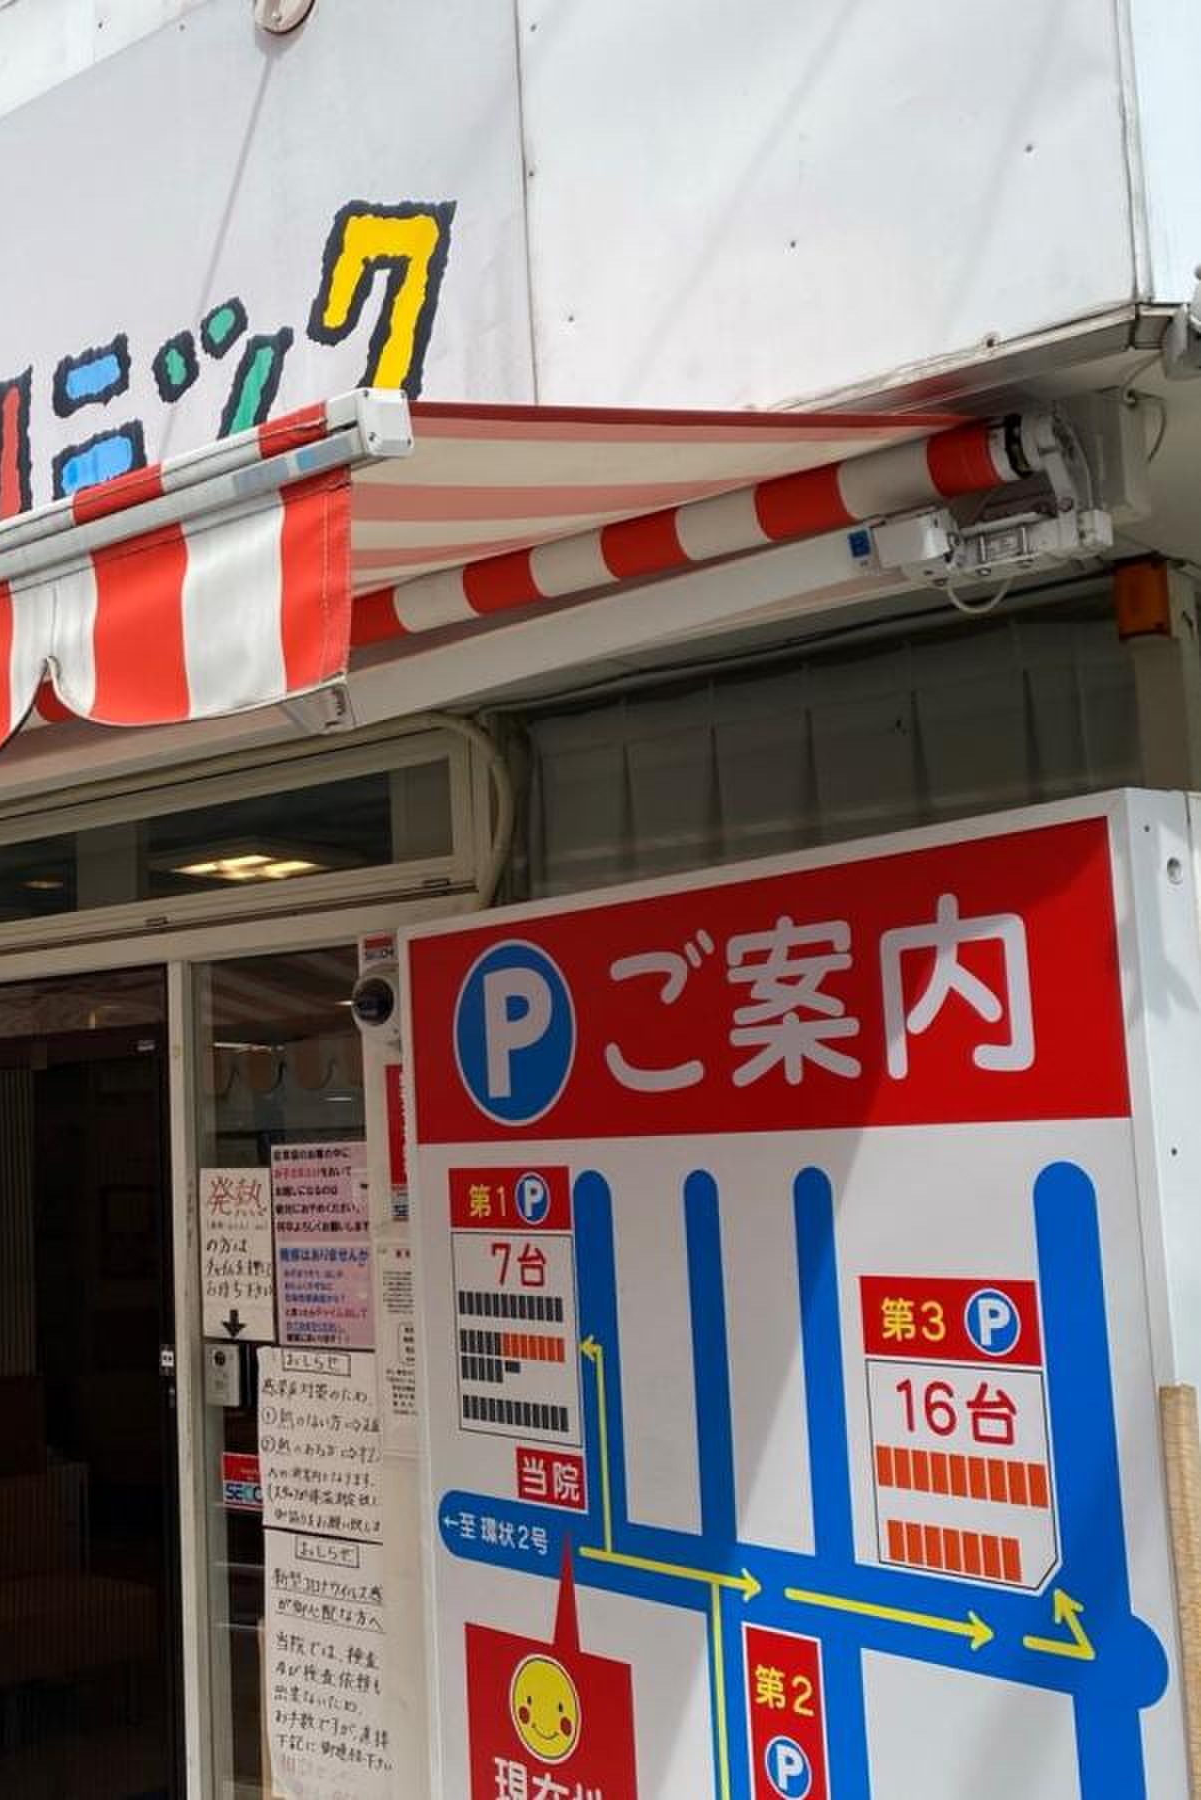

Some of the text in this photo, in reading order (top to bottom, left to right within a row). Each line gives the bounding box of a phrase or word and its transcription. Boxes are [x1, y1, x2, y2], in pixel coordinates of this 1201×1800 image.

[604, 893, 1036, 1091] ご案内
[209, 1175, 267, 1217] 発熱
[469, 1183, 506, 1218] 第1
[491, 1242, 547, 1287] 7台
[881, 1296, 946, 1342] 第3
[896, 1377, 1017, 1445] 16台
[522, 1456, 580, 1501] 当院
[755, 1664, 815, 1717] 第2
[494, 1756, 603, 1800] 現在
